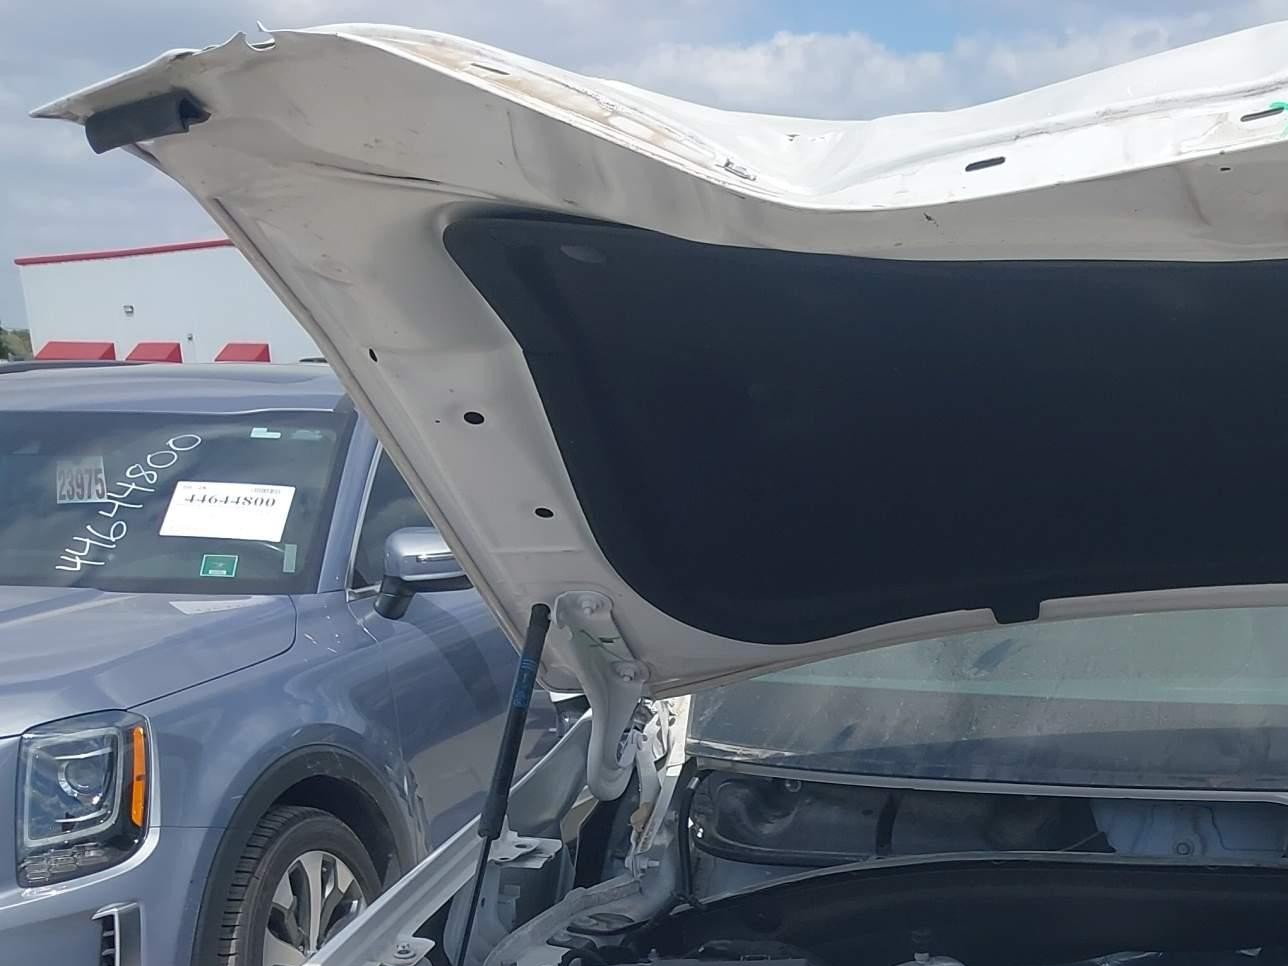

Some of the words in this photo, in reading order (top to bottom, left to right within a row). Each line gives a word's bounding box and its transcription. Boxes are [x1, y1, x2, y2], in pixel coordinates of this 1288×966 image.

[58, 467, 106, 500] 23975
[55, 433, 202, 572] 44644800
[184, 494, 276, 508] 44644800
